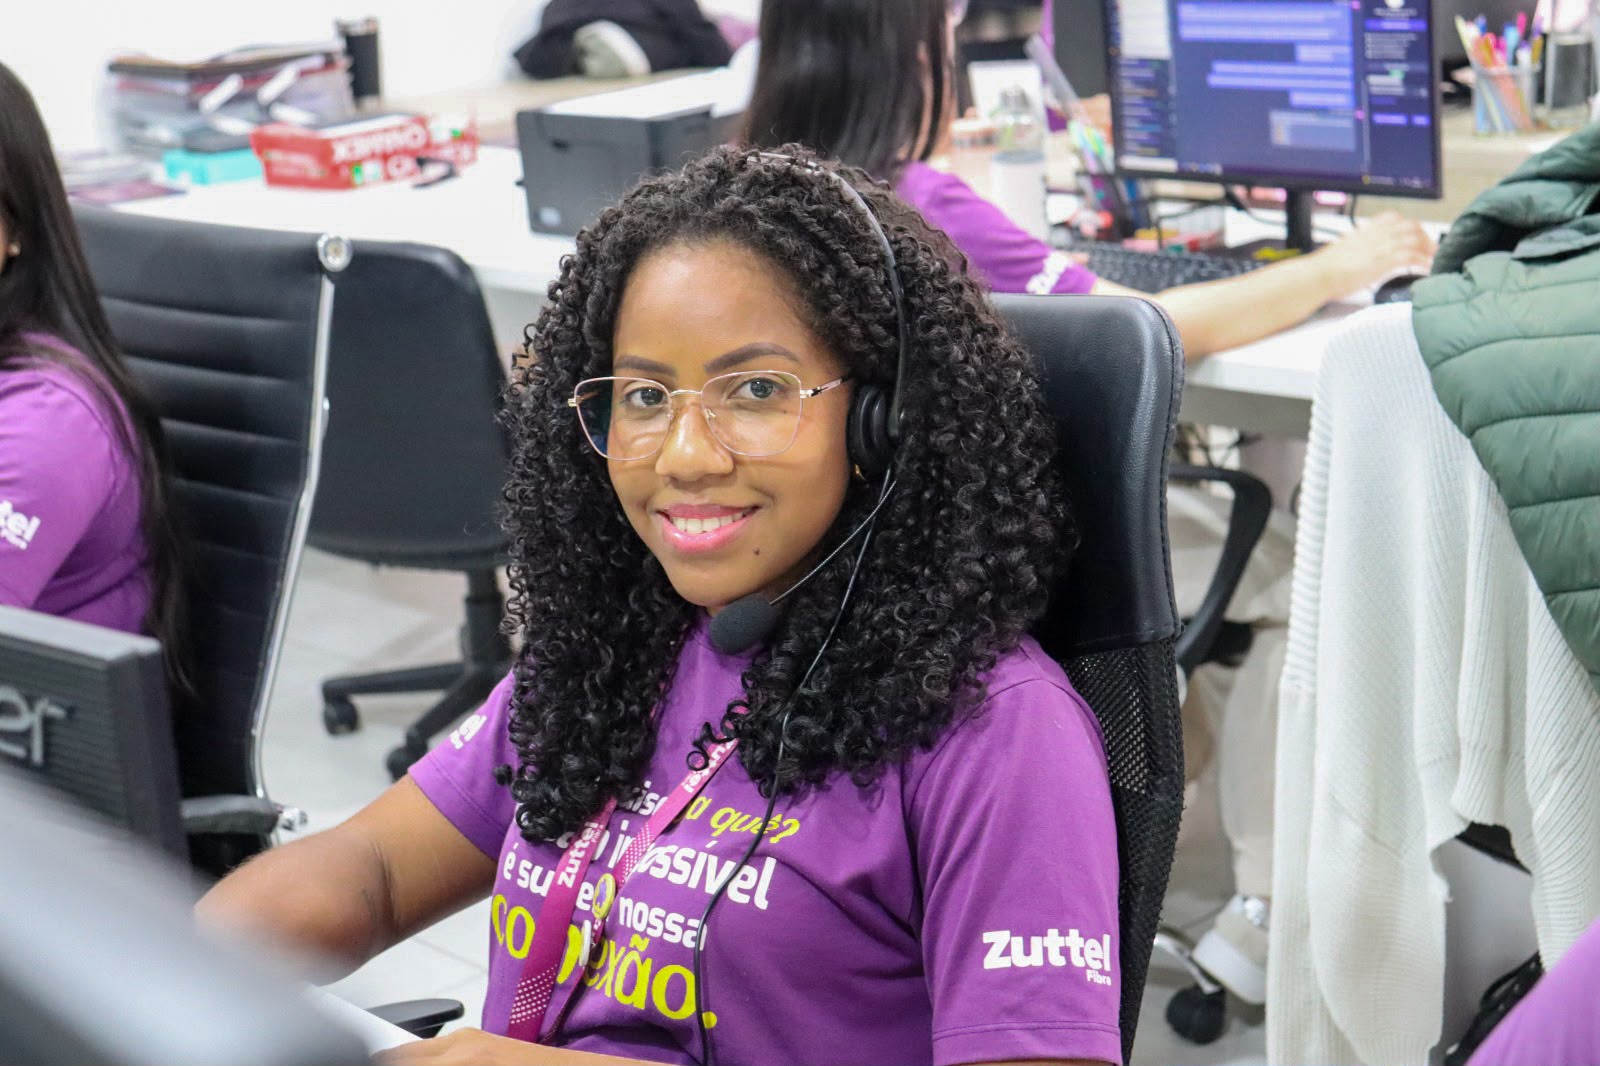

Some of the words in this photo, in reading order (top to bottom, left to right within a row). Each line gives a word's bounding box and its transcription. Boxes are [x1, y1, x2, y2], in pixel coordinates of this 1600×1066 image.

[557, 821, 599, 889] Zuttel
[503, 842, 519, 881] é
[619, 896, 708, 951] nossa
[983, 928, 1111, 972] Zuttel
